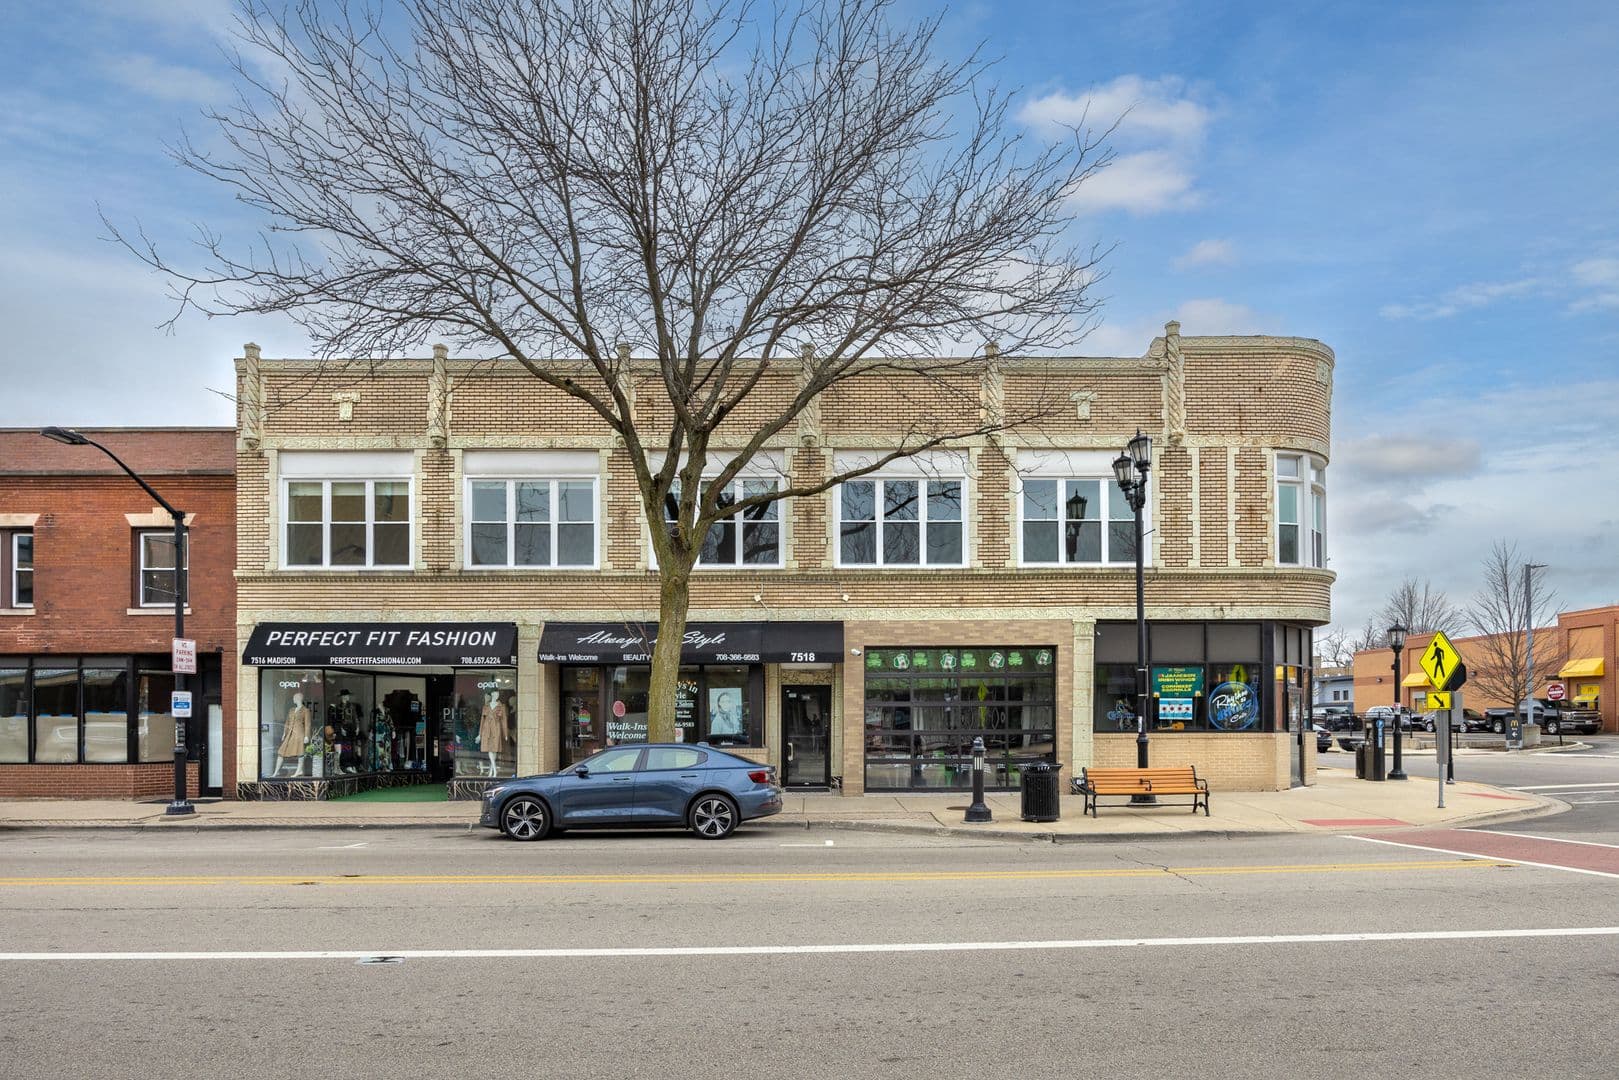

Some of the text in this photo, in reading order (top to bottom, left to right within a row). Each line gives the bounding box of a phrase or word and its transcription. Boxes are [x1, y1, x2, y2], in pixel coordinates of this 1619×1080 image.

[266, 631, 496, 646] PERFECT FIT FASHION
[576, 630, 643, 649] Always
[681, 630, 726, 649] Style
[251, 656, 296, 664] 7516 MADISON
[330, 656, 422, 665] PERFECTFITFASHION4U.COM
[568, 653, 598, 661] Welcome
[623, 653, 651, 661] BEAUTY
[791, 652, 816, 662] 7518
[279, 681, 300, 689] open
[477, 681, 498, 690] open
[608, 722, 647, 731] Walk-Ins
[609, 731, 647, 740] Welcome
